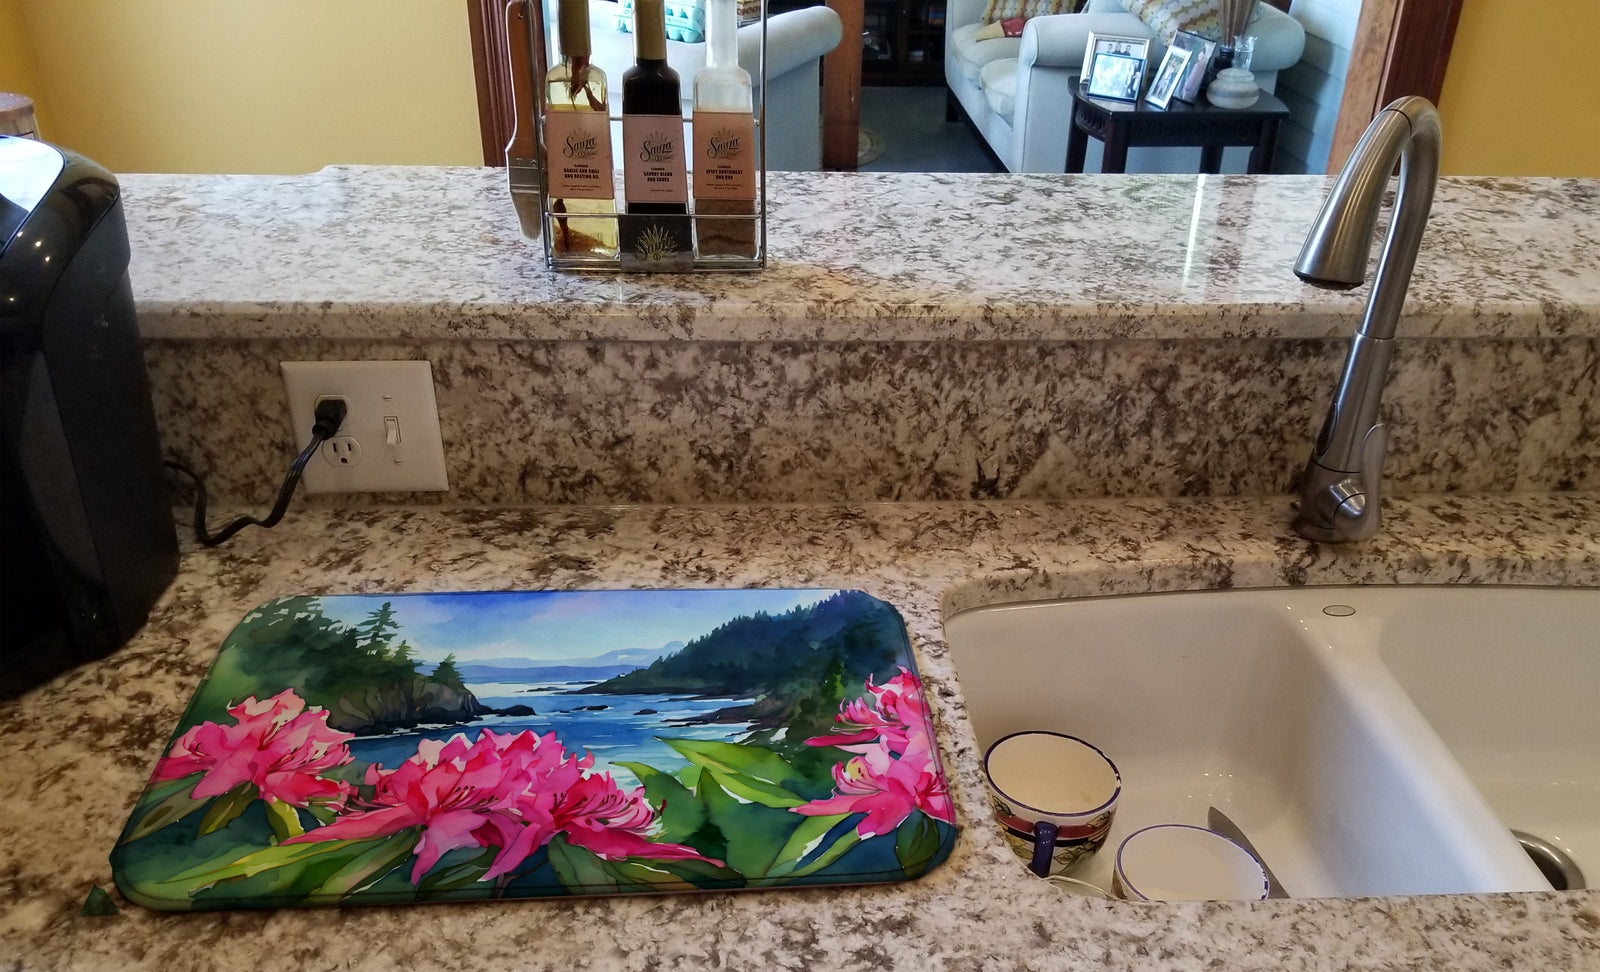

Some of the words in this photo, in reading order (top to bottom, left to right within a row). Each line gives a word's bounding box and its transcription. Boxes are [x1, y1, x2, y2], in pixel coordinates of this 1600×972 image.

[563, 136, 597, 158] Sauza
[640, 140, 673, 161] Sauza
[707, 137, 739, 158] Sauza
